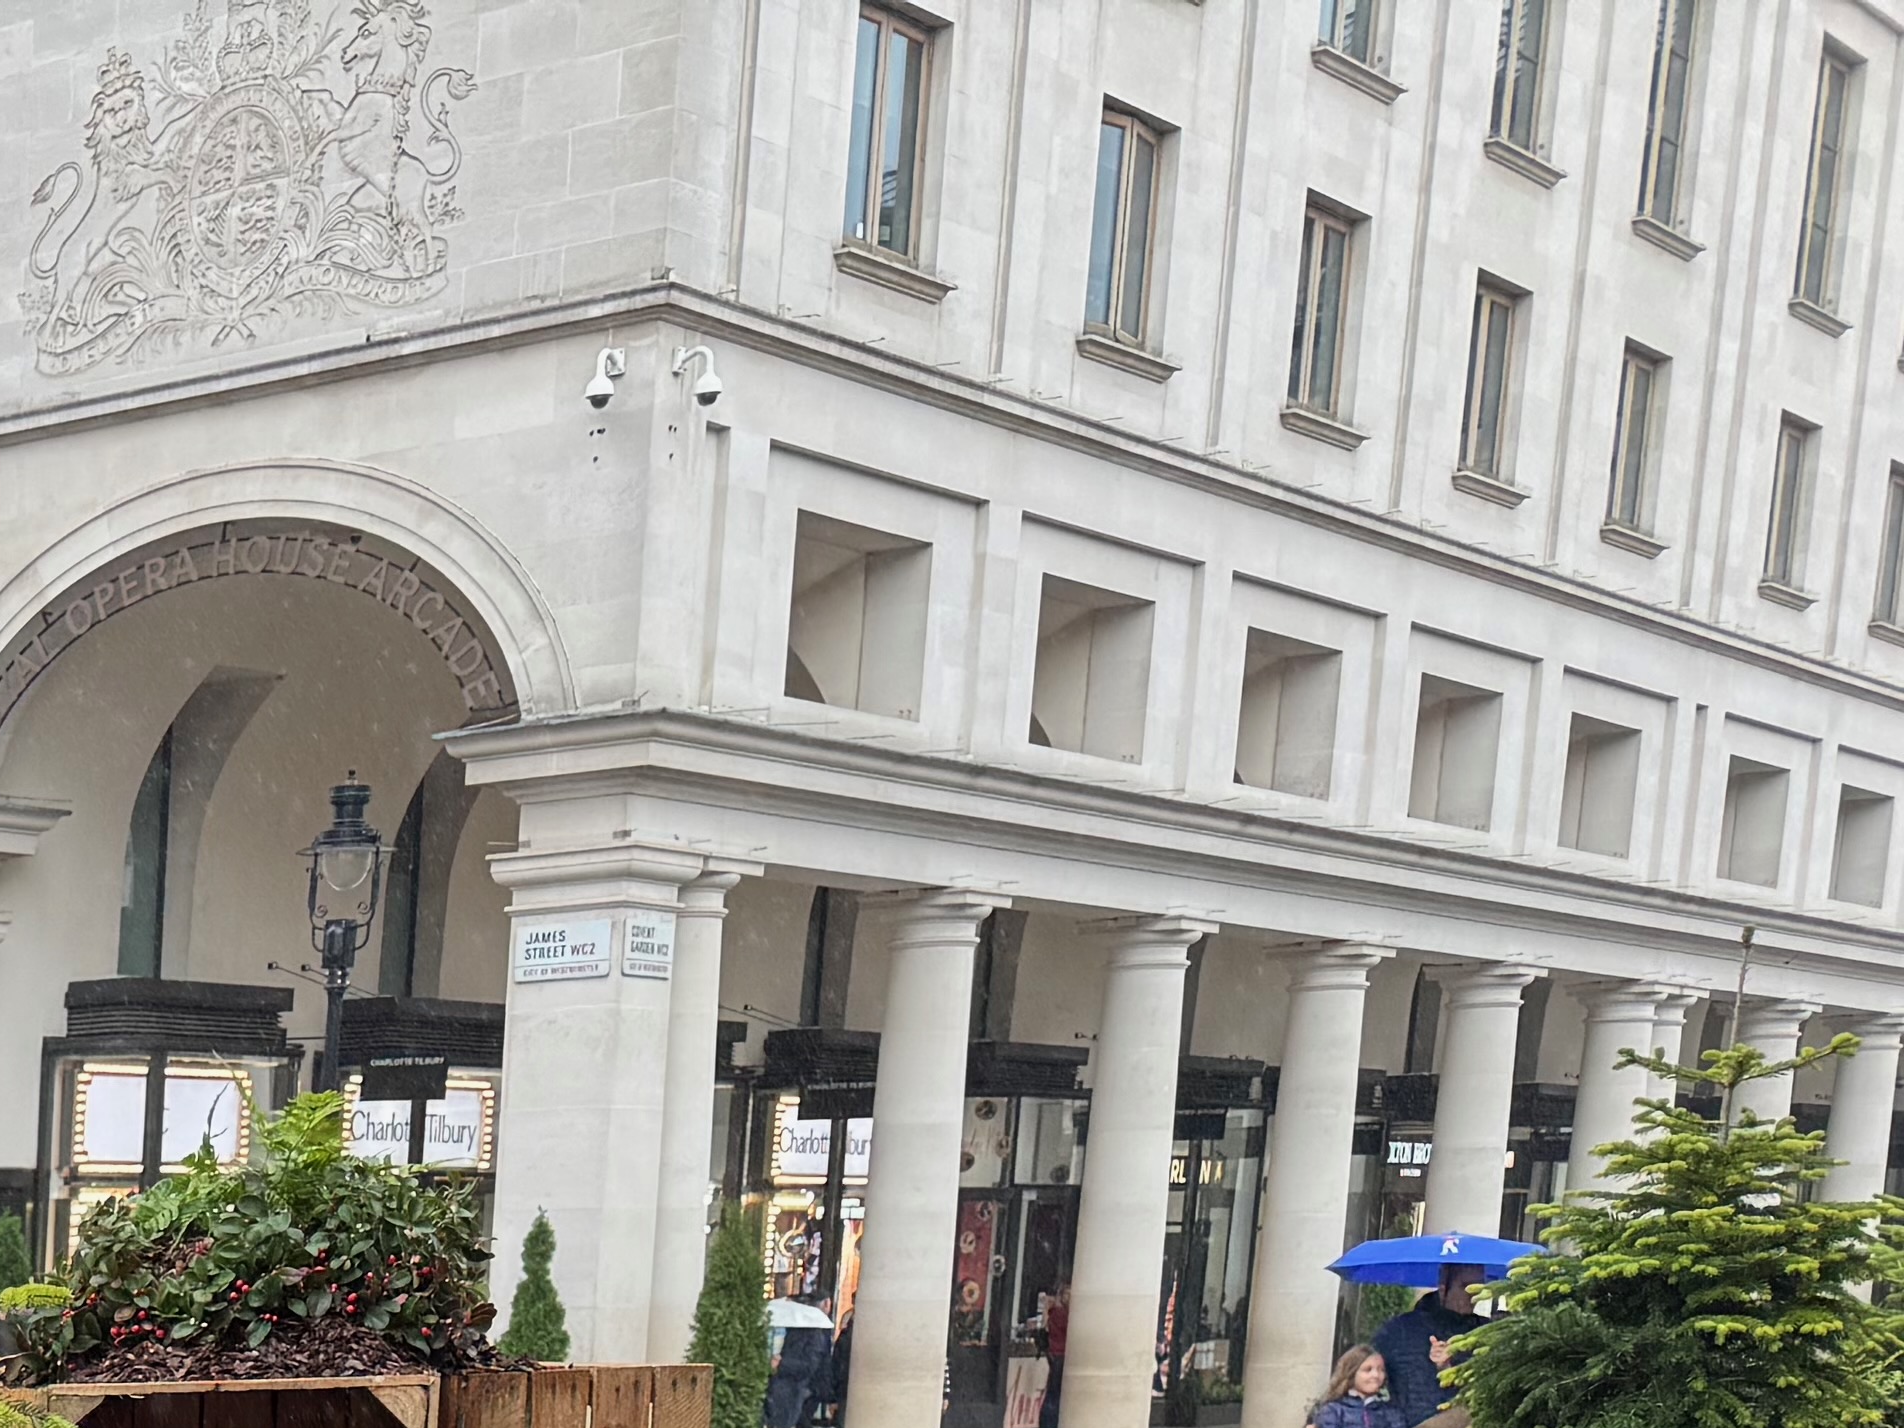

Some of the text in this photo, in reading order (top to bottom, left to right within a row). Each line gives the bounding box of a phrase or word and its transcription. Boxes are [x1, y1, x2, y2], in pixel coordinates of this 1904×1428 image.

[66, 548, 199, 637] OPERA
[211, 534, 360, 582] HOUSE
[357, 557, 502, 709] ARCADE
[525, 929, 566, 945] JAMES
[524, 943, 596, 960] STREET WC2
[425, 1114, 477, 1152] Tilbury
[780, 1127, 830, 1155] Charlott
